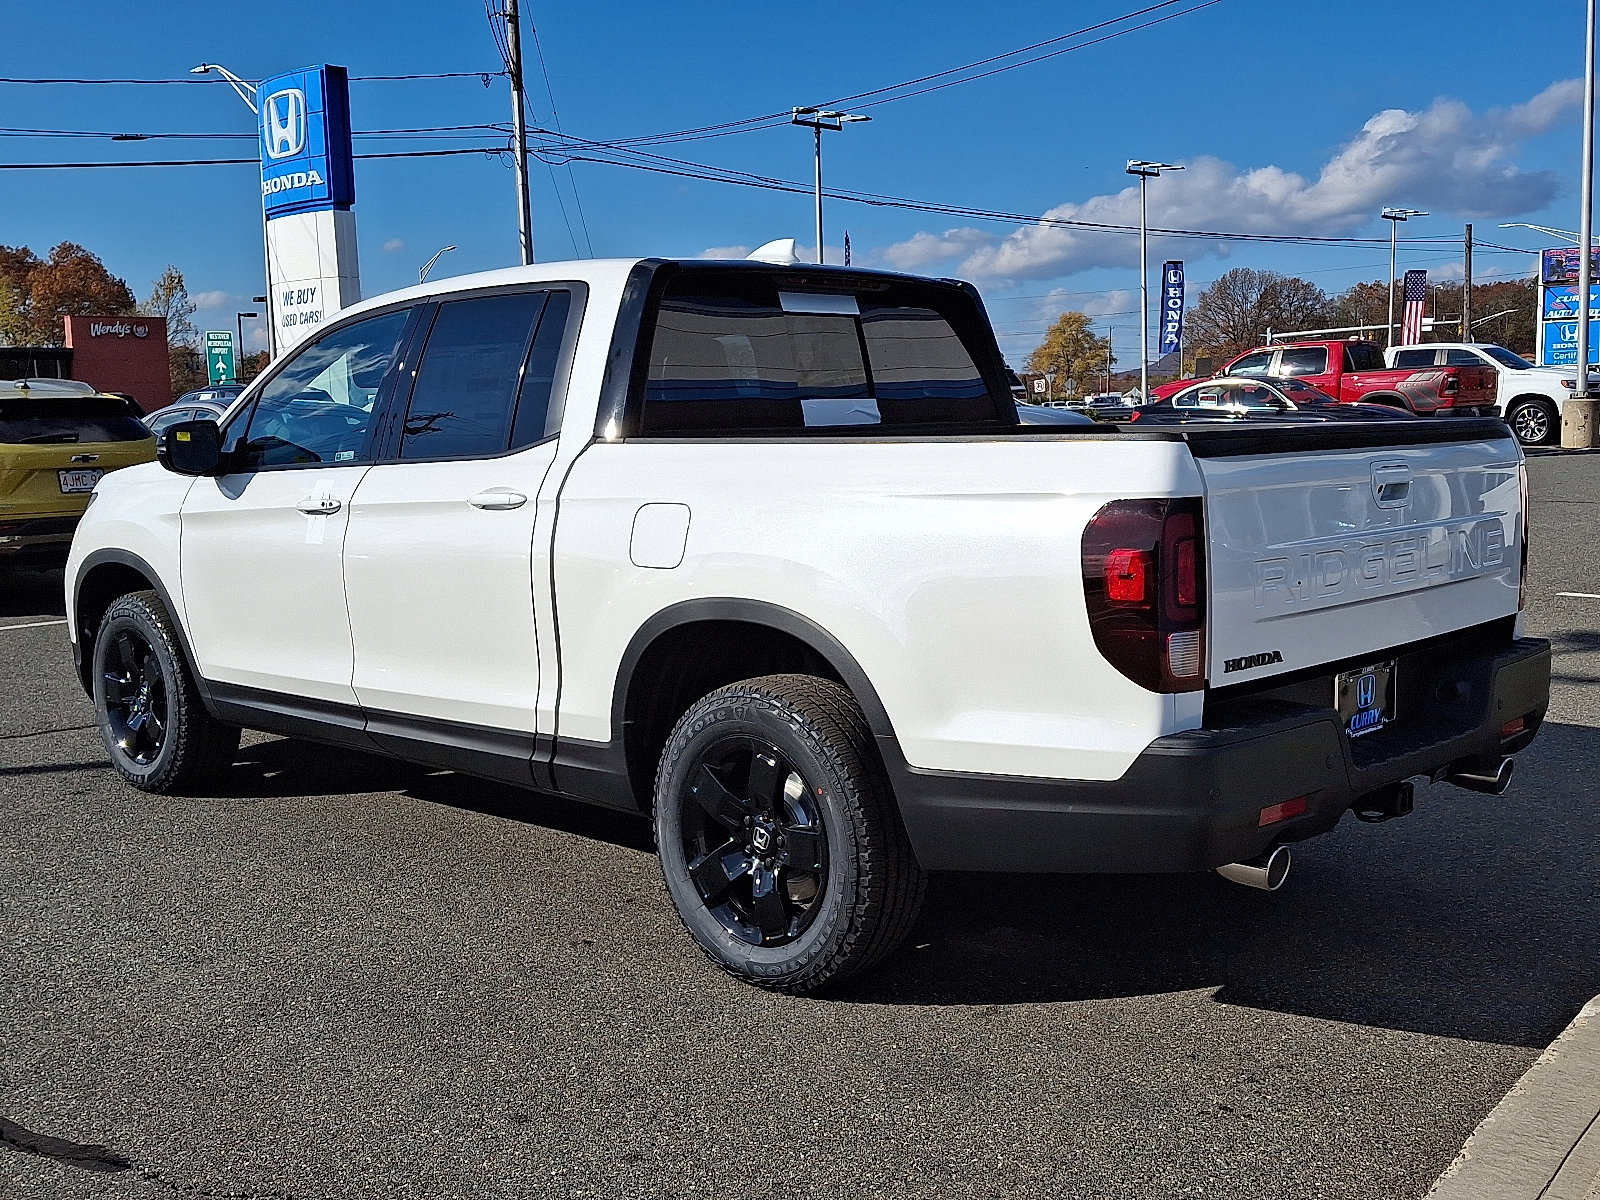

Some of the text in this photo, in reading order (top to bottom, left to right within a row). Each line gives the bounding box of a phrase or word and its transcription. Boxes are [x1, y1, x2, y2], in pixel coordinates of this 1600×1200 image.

[262, 170, 324, 195] HONDA
[283, 286, 317, 306] WE BUY
[1556, 294, 1599, 303] CURY
[282, 309, 322, 327] USED CARS!
[1165, 287, 1182, 343] HONDA
[91, 320, 131, 338] Wendy's
[212, 347, 229, 355] AIRPORT
[1553, 351, 1579, 360] Certif
[1252, 529, 1505, 609] RIDGELINE
[1223, 650, 1285, 673] HONDA
[1350, 707, 1382, 730] CURRY
